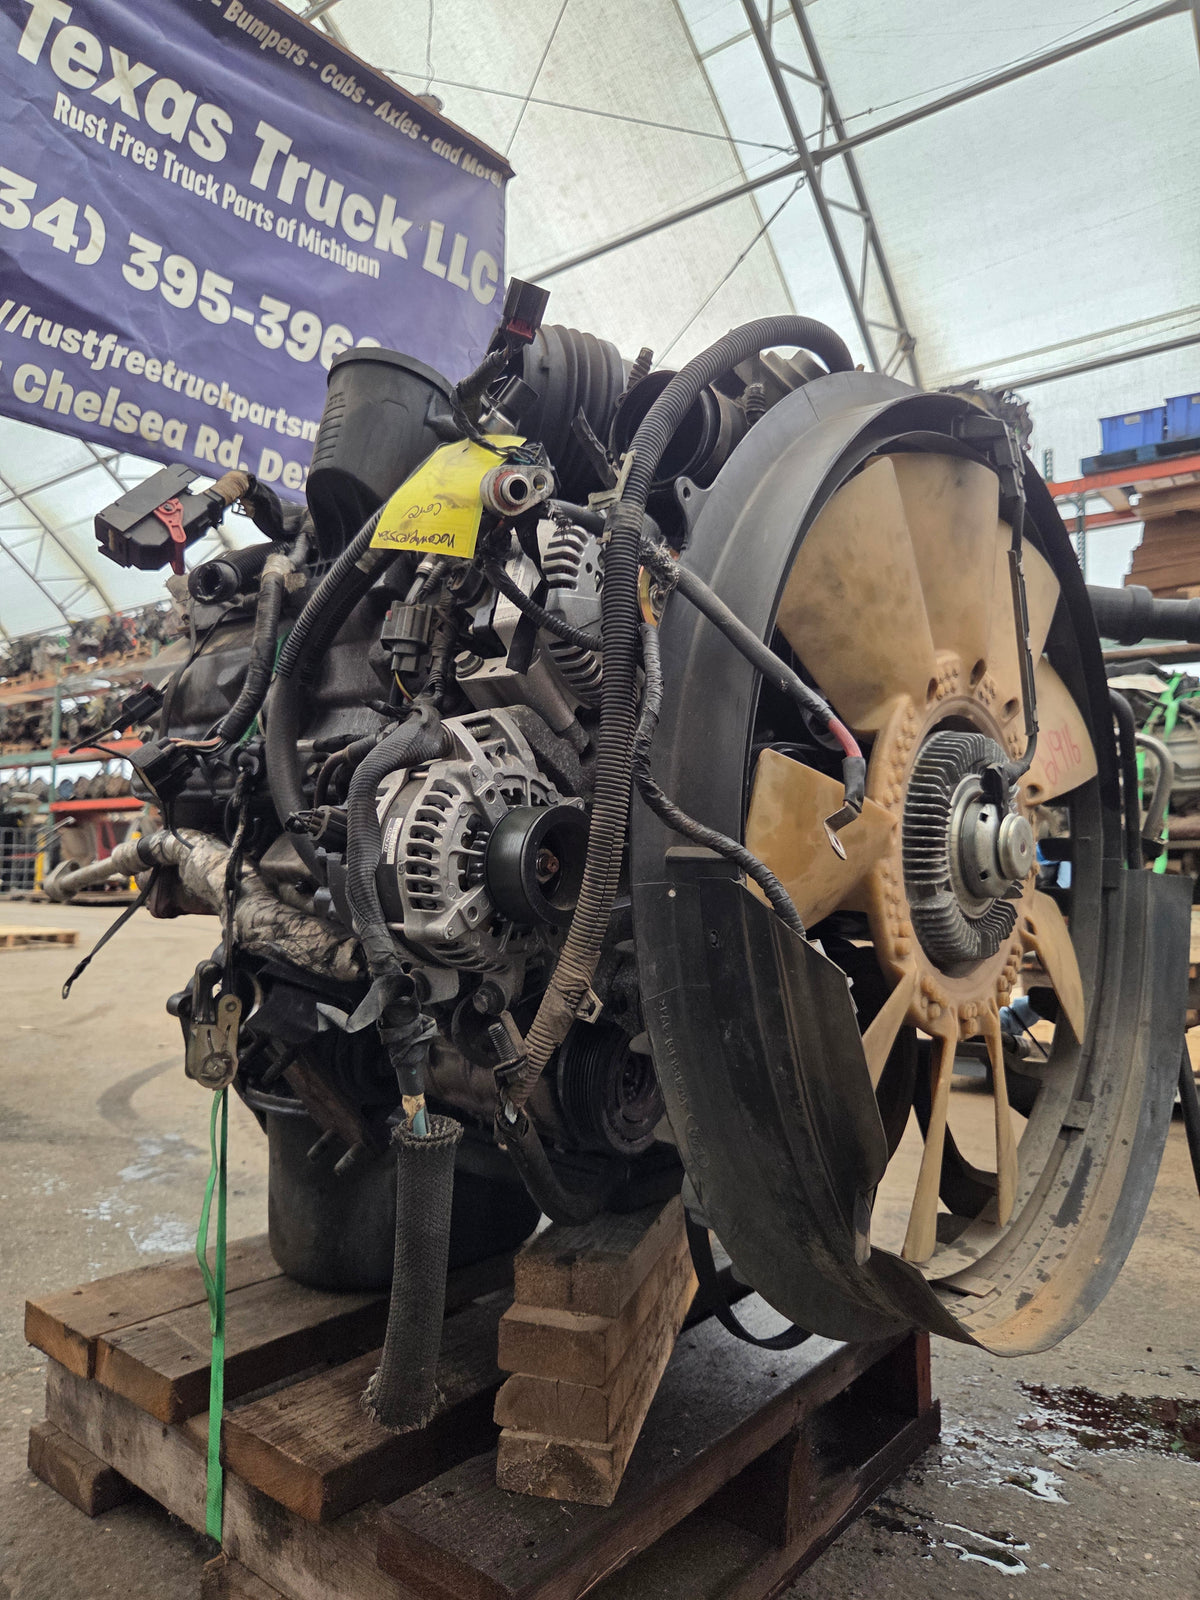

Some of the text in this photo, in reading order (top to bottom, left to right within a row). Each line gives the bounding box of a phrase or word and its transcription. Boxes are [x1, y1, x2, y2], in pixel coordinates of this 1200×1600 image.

[17, 0, 499, 306] Texas Truck LLC
[223, 0, 309, 66] Bumpers
[320, 63, 366, 104] Cabs
[374, 101, 422, 140] Axles
[431, 136, 464, 165] and
[53, 91, 380, 279] Rust Free Truck Parts of Michigan
[122, 232, 381, 371] 395-396
[13, 363, 188, 451] Chelsea
